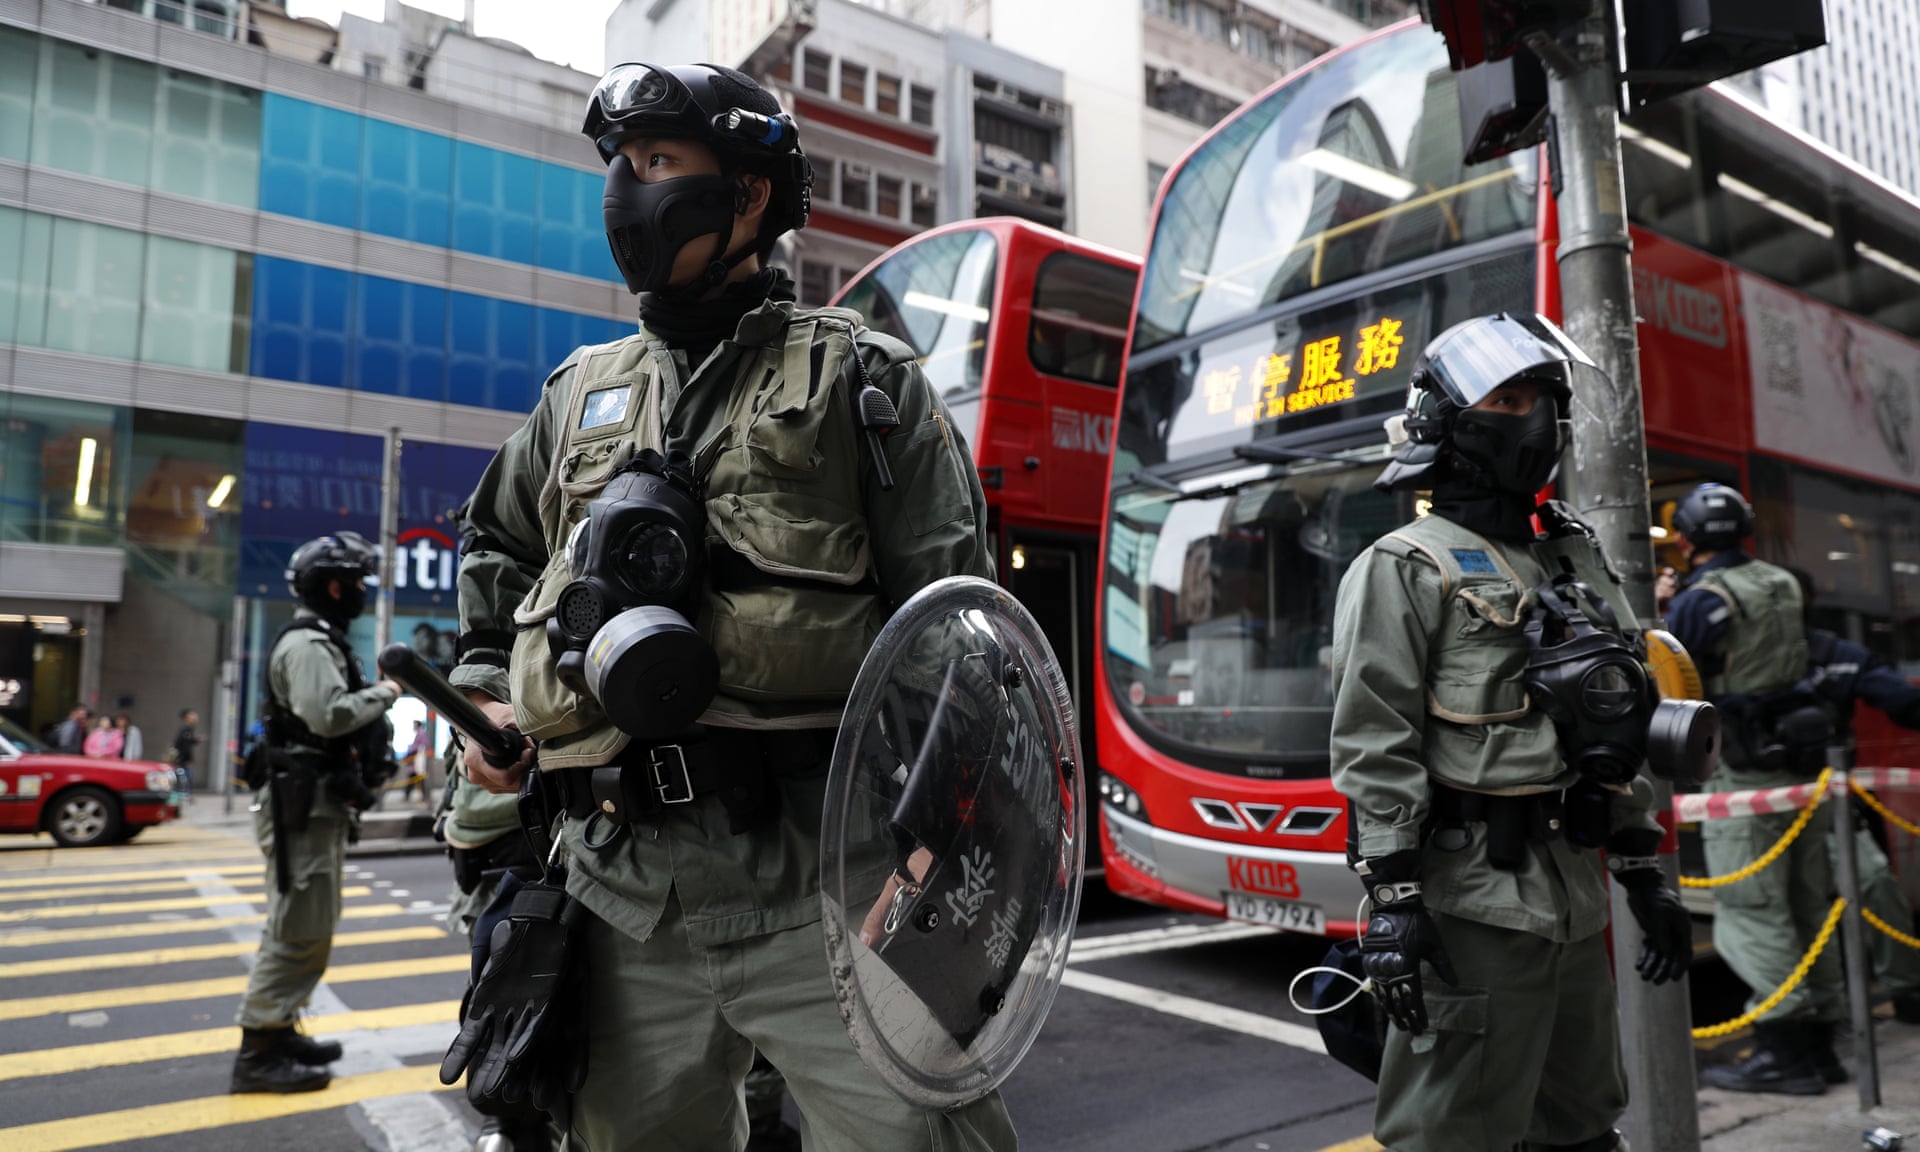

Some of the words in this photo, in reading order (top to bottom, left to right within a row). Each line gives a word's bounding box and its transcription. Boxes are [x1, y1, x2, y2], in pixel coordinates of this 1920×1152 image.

[1287, 378, 1355, 413] SERVICE
[1226, 855, 1302, 899] KMB
[1263, 901, 1316, 928] 9794
